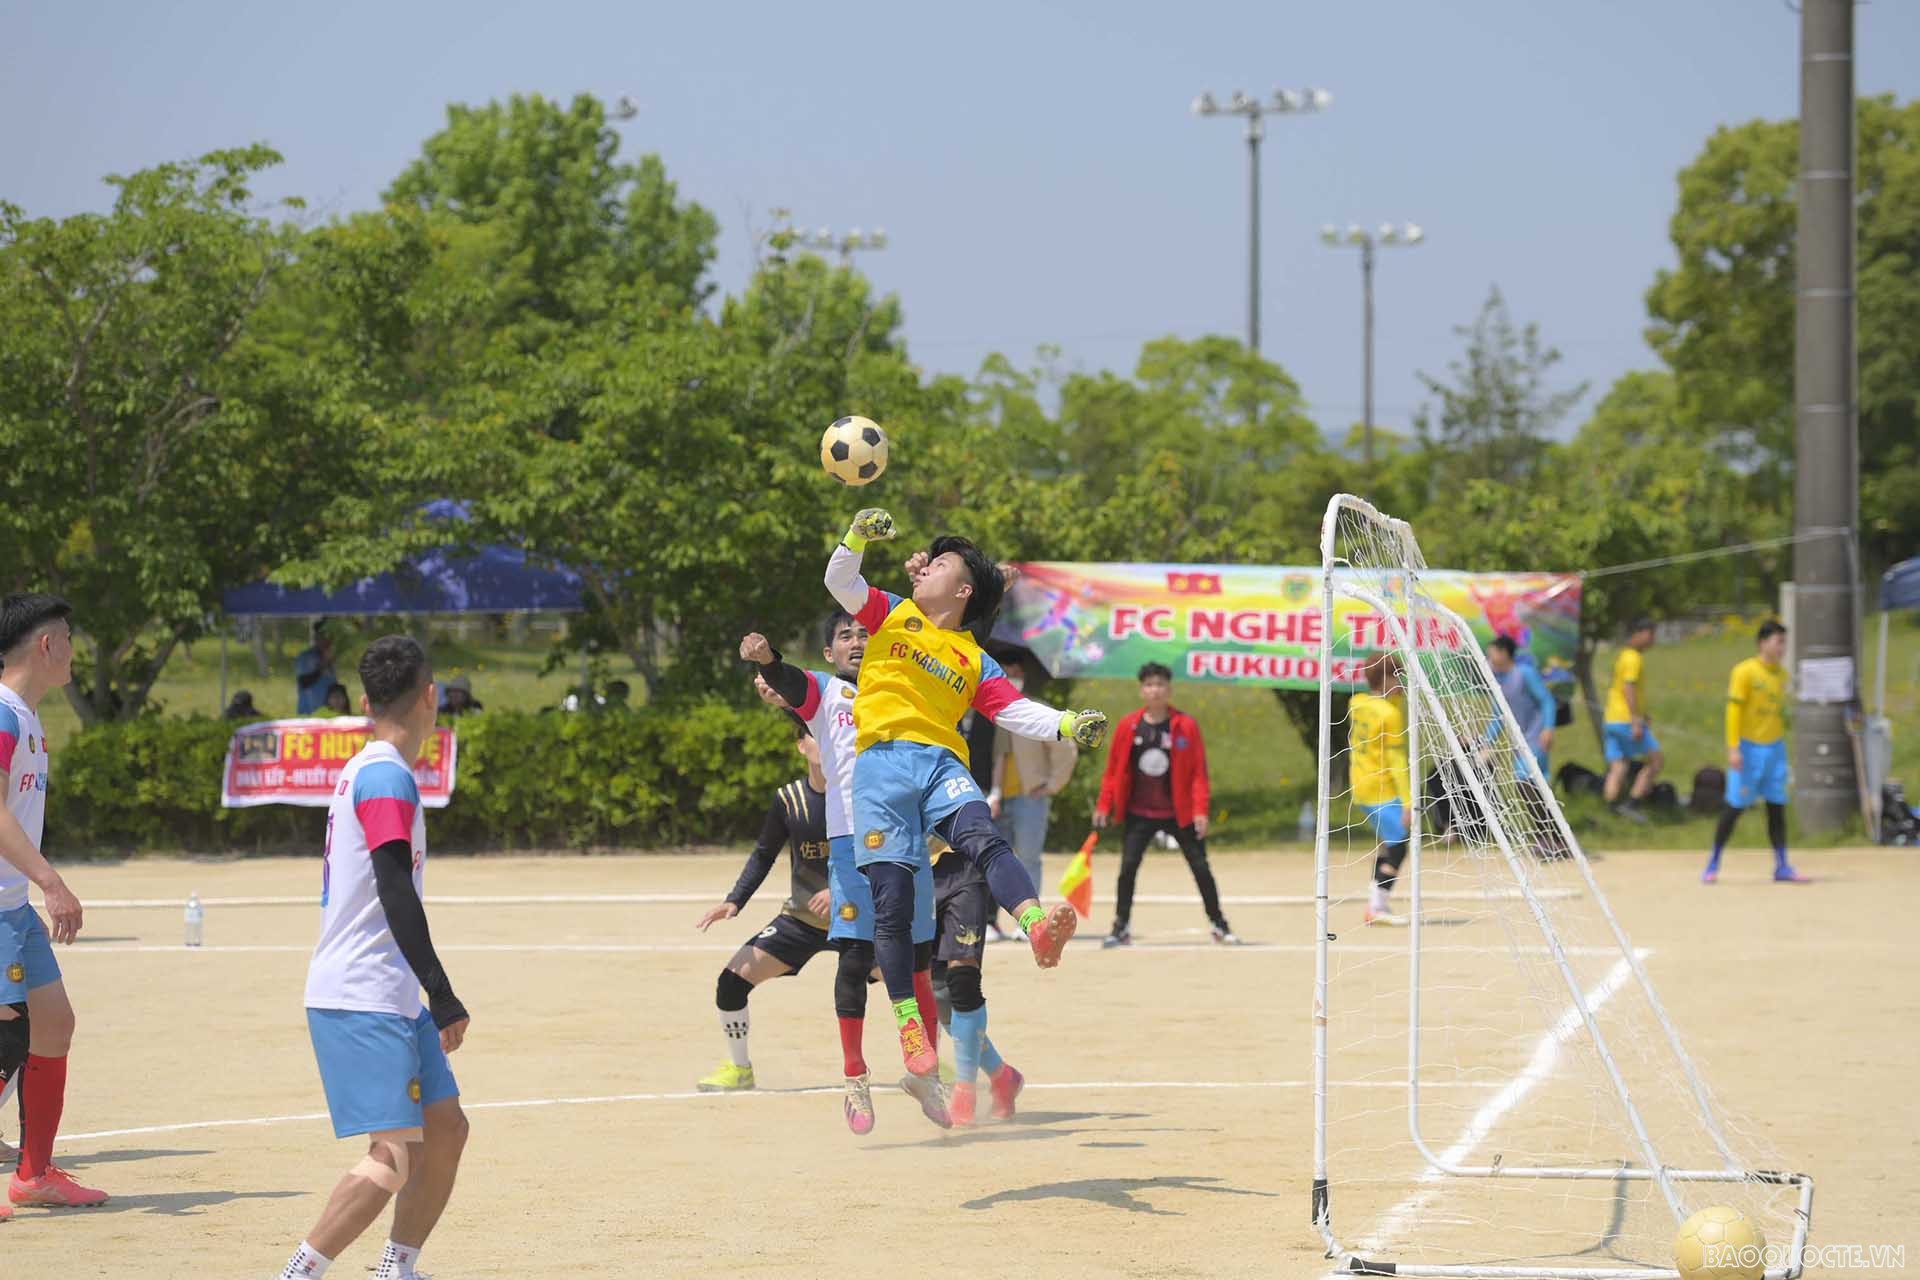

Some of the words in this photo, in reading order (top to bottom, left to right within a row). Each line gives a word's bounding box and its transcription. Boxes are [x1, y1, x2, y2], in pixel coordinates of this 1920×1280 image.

[1112, 608, 1173, 639] FC
[890, 642, 909, 658] FC
[911, 648, 967, 694] KACHITAI
[282, 732, 315, 760] FC
[944, 776, 974, 800] 22
